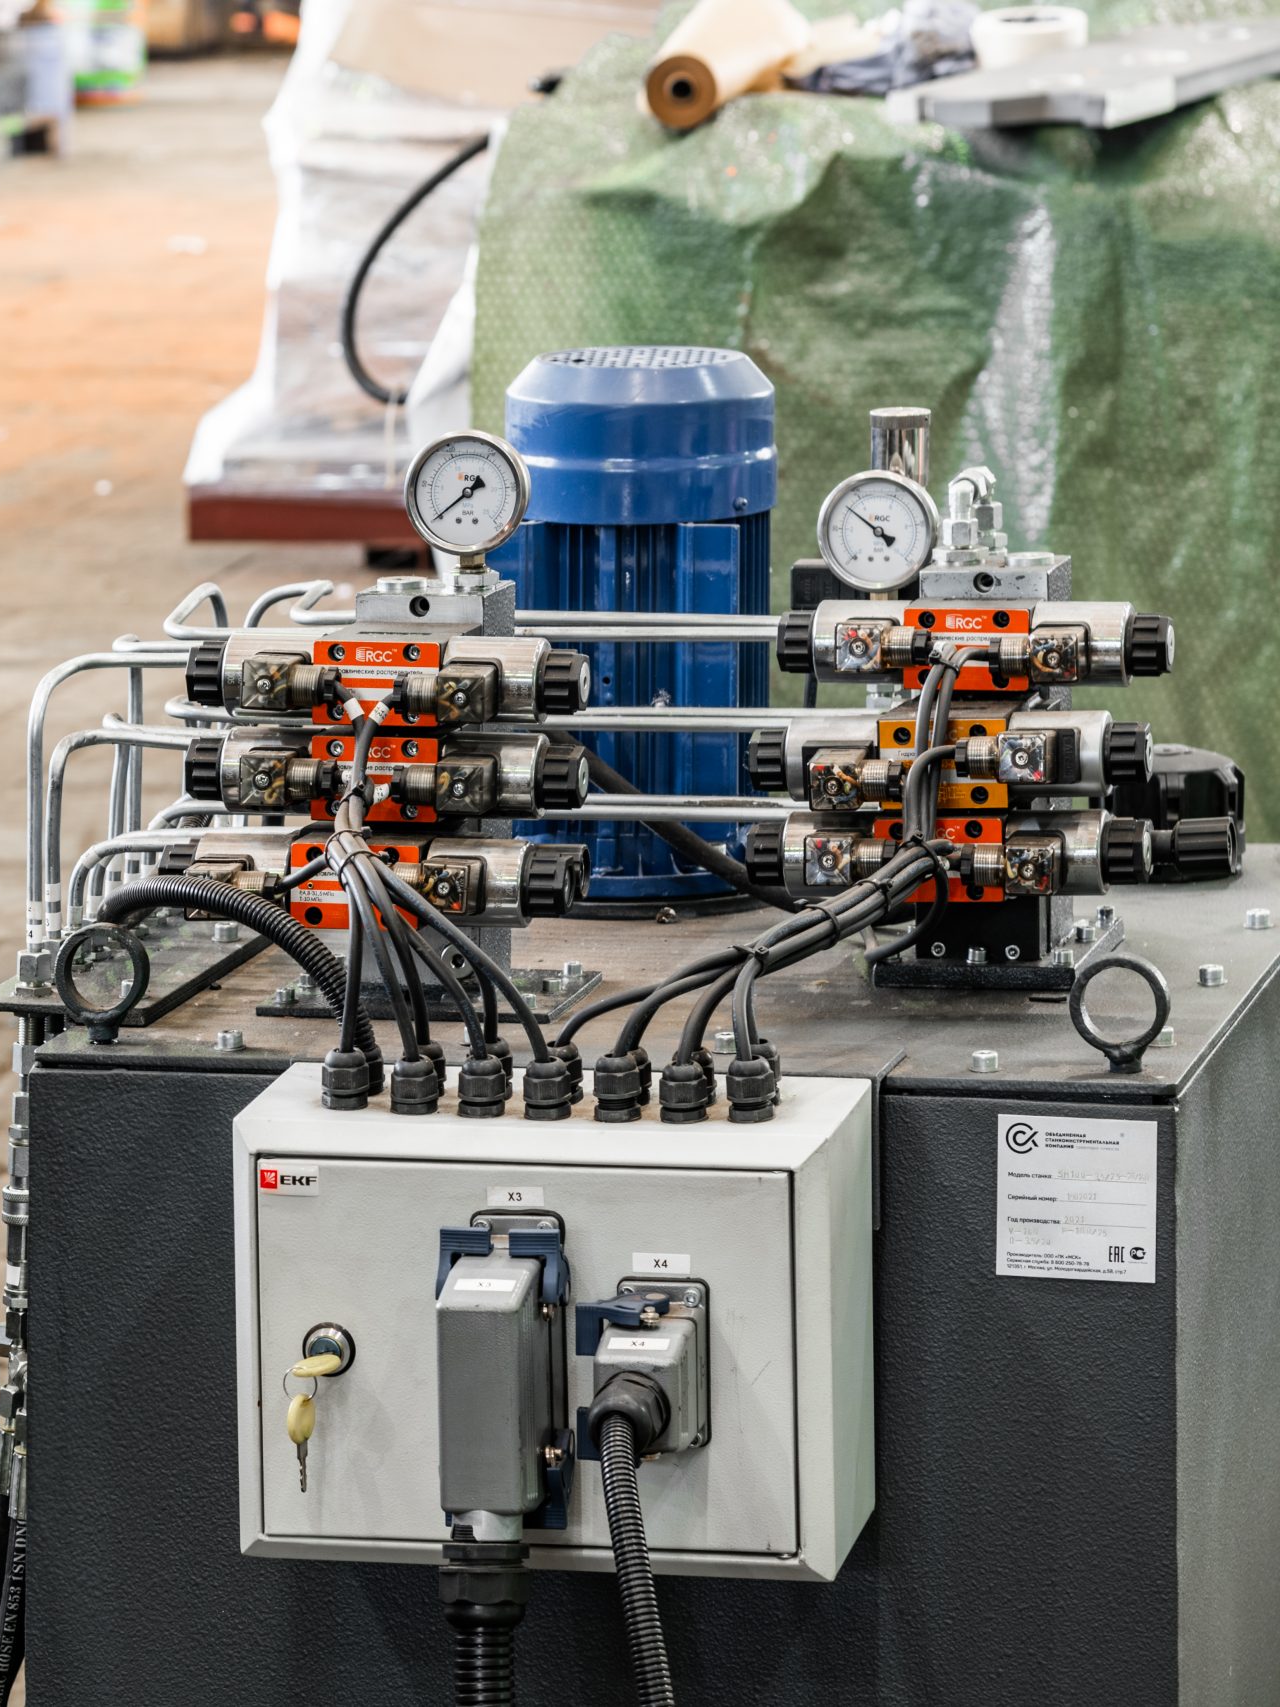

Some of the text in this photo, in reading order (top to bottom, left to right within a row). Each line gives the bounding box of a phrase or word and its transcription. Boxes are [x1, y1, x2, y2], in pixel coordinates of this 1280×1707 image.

[280, 1175, 317, 1186] EKF
[507, 1192, 522, 1202] X3
[654, 1259, 668, 1269] X4
[7, 1586, 21, 1611] 853
[4, 1612, 18, 1633] EN
